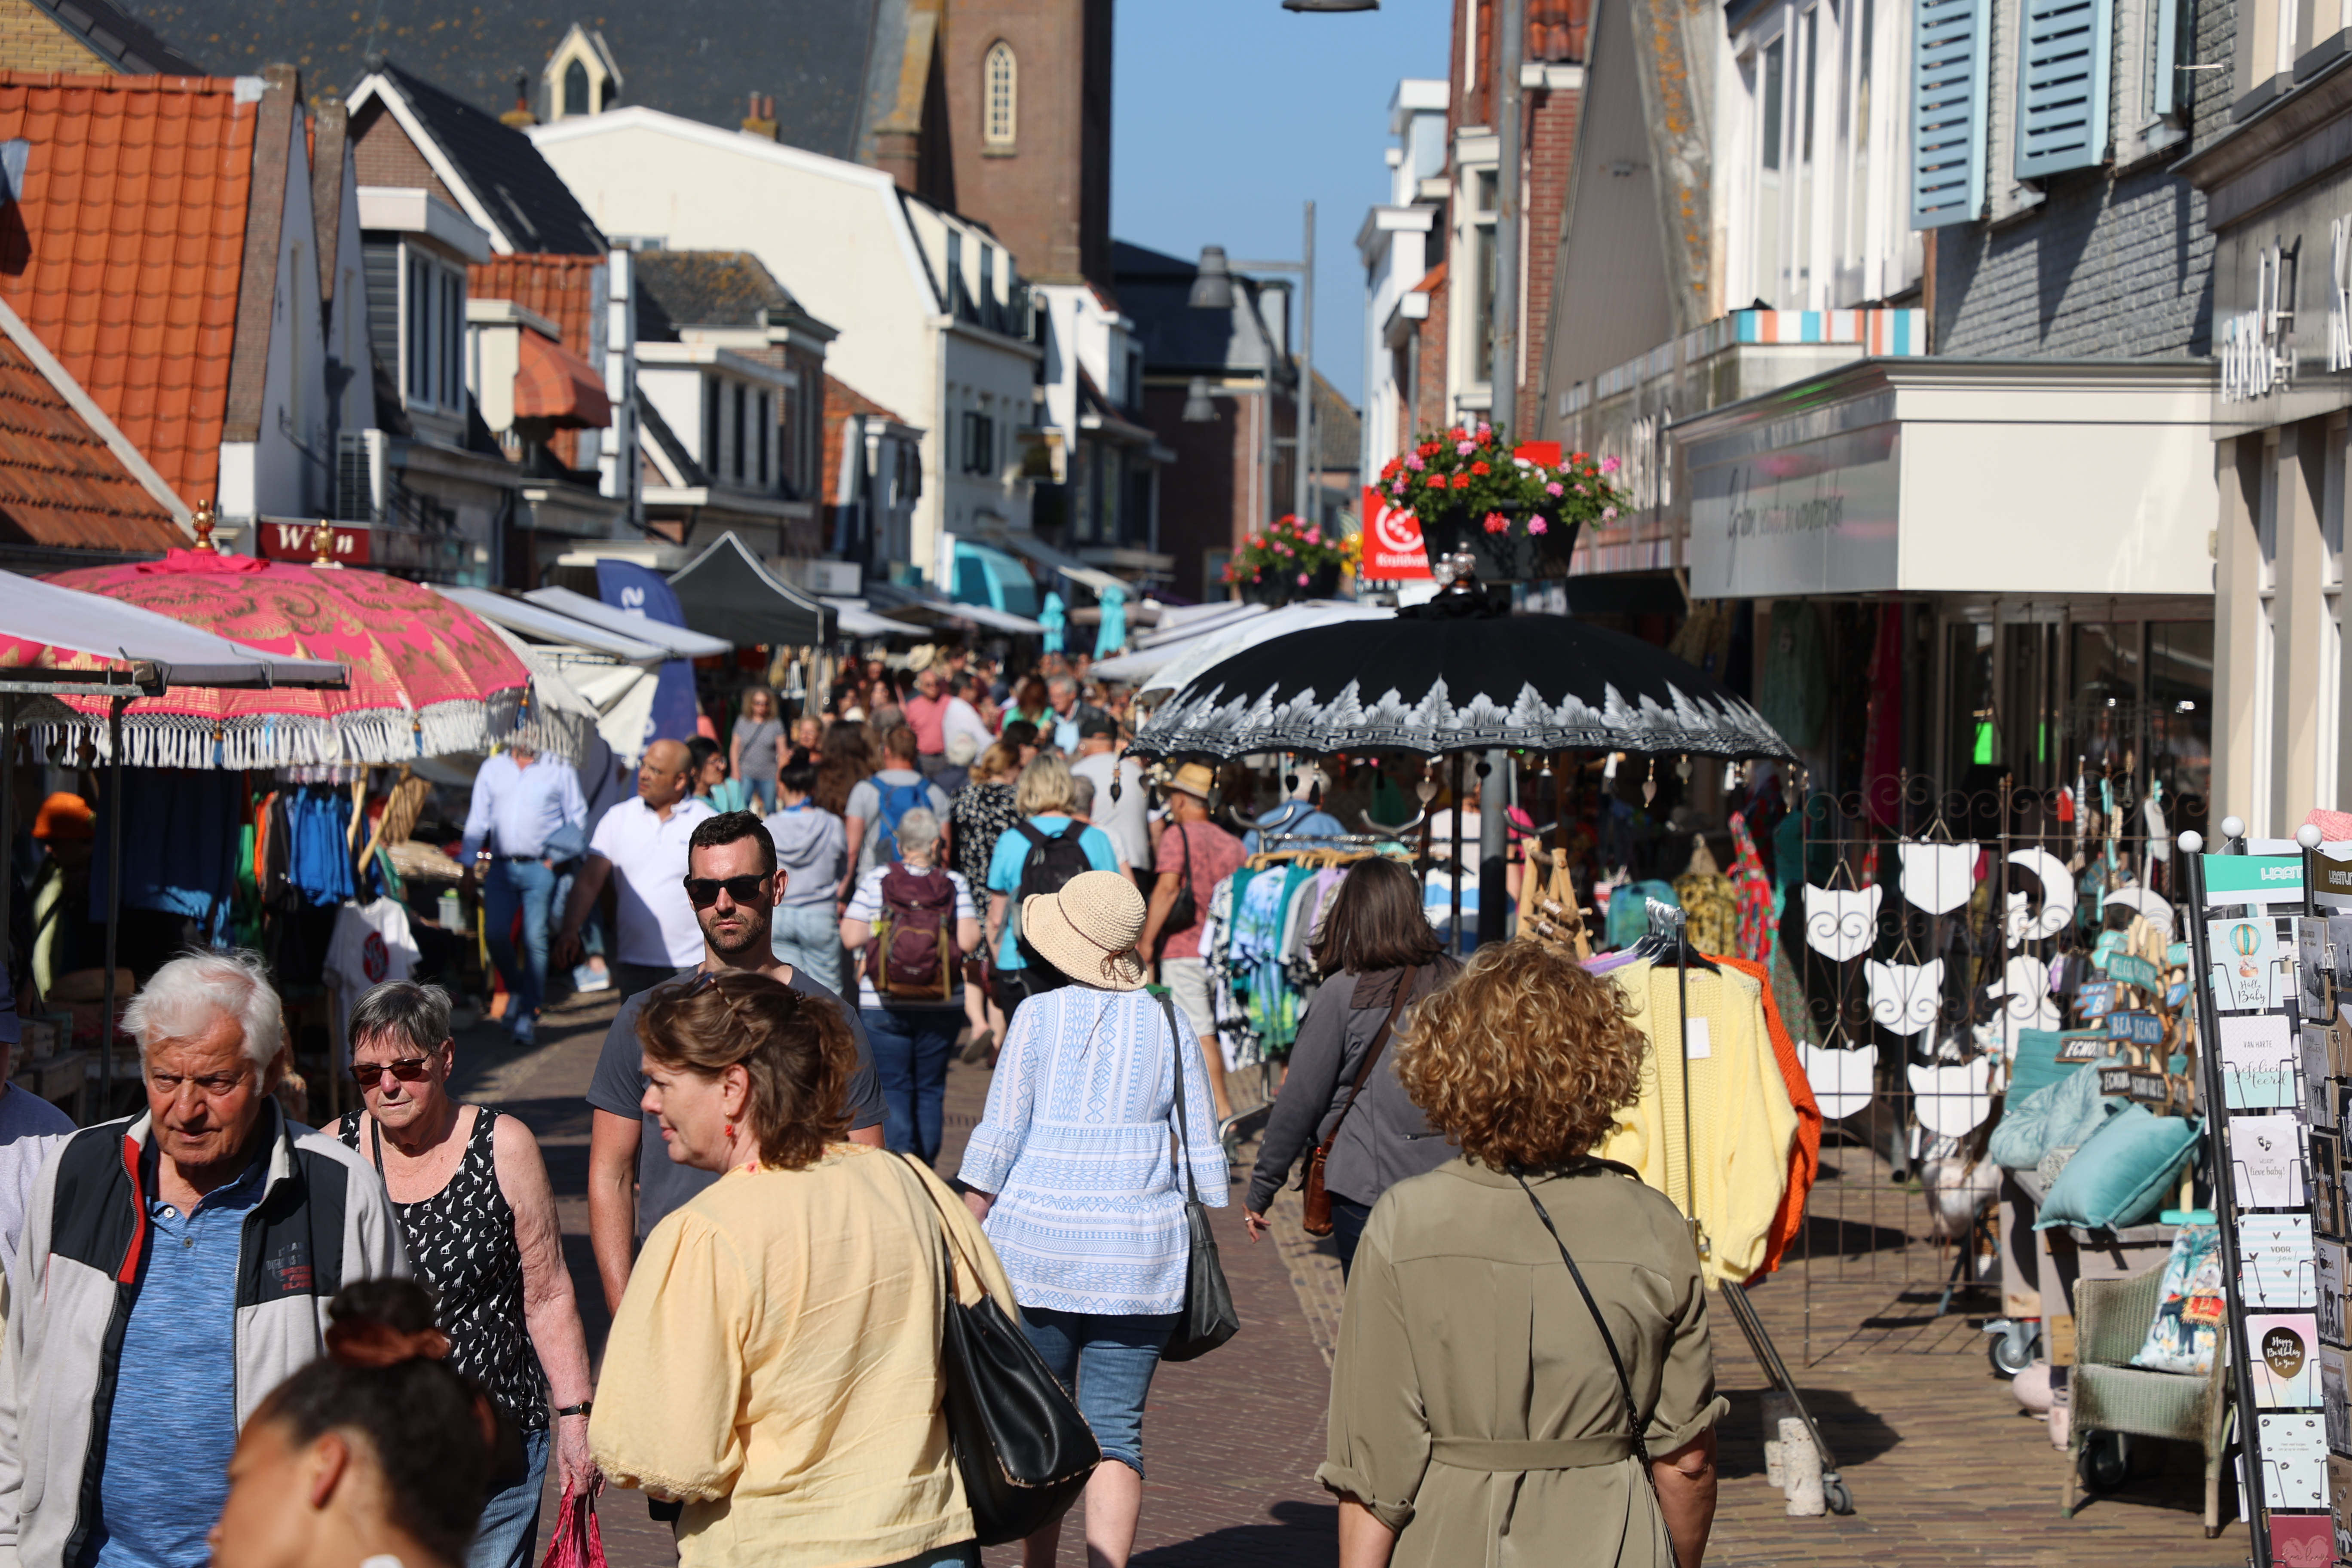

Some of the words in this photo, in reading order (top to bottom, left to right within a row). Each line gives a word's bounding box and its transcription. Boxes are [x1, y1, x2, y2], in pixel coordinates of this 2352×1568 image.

[2238, 989, 2266, 1005] Baby
[2135, 1018, 2158, 1040] BEACH
[2233, 1059, 2280, 1084] gefelici
[2251, 1071, 2288, 1089] teerd
[2250, 1166, 2265, 1176] lieve
[2266, 1166, 2285, 1179] baby!
[2275, 1251, 2297, 1265] jou!
[2272, 1336, 2294, 1348] Happy
[2267, 1347, 2301, 1358] Birthday
[2274, 1357, 2282, 1367] to
